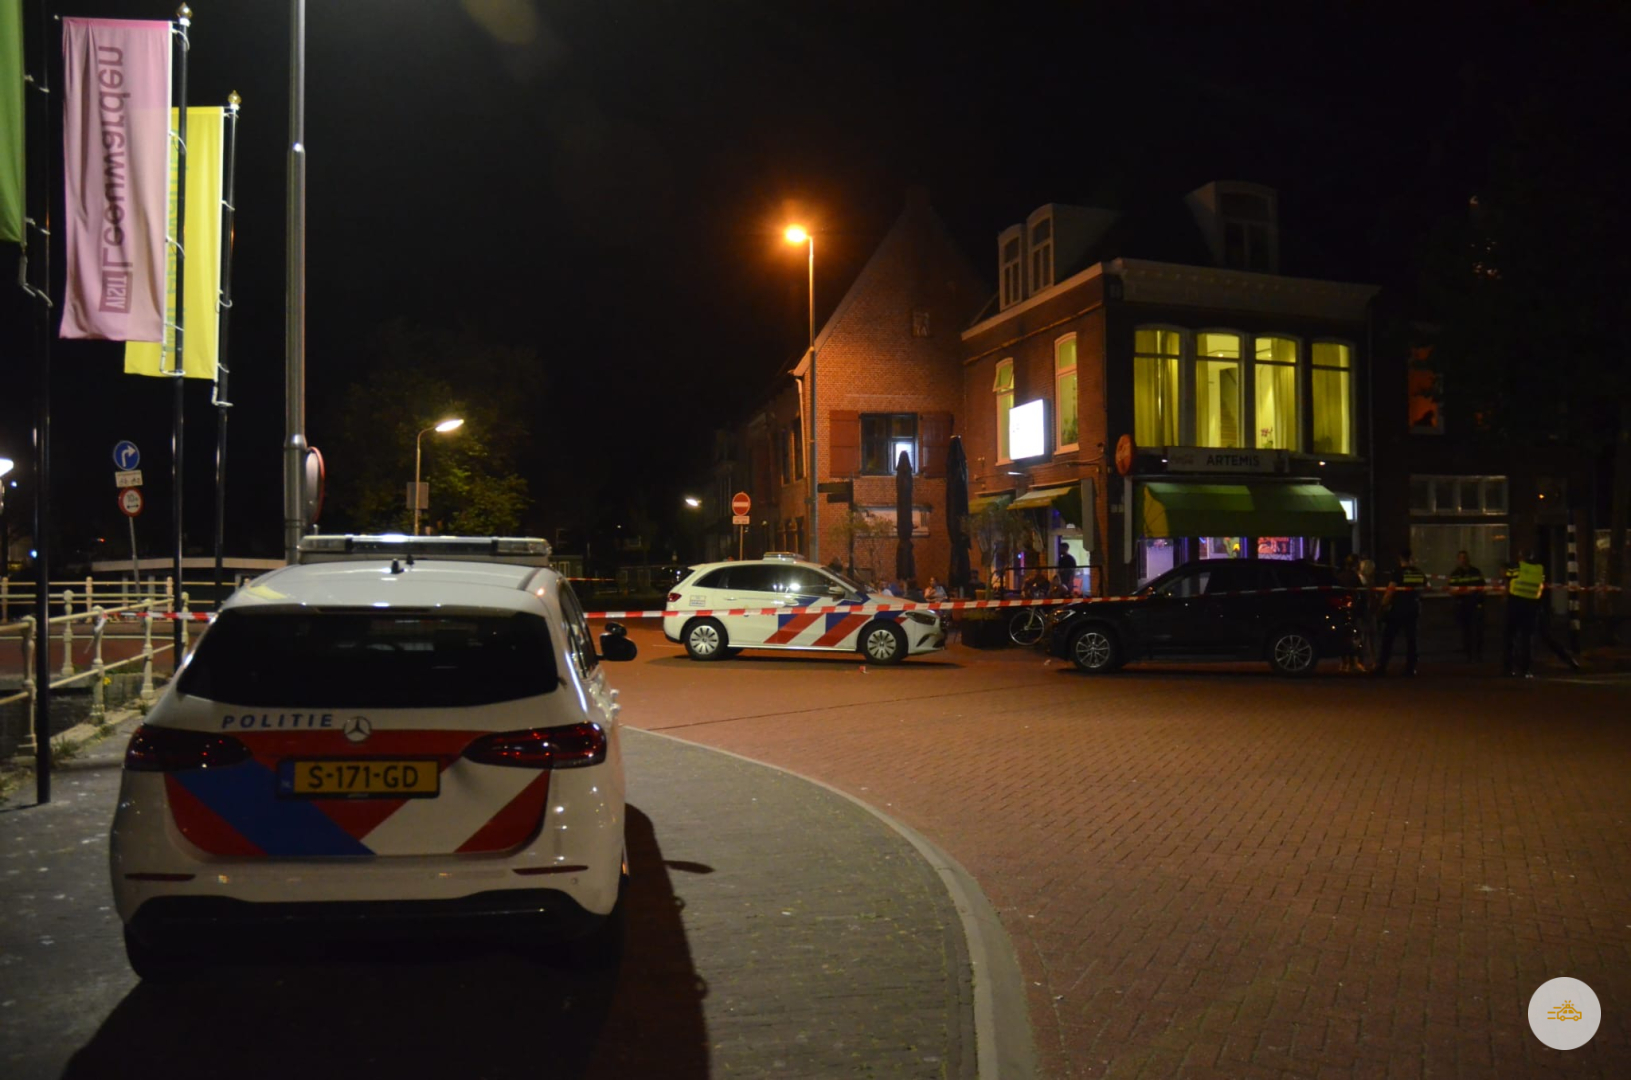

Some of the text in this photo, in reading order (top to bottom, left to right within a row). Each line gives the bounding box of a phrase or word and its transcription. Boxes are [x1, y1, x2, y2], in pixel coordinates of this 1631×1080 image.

[1206, 454, 1260, 466] ARTEMIS
[222, 713, 333, 729] POLITIE
[308, 765, 418, 789] S-171-GD
